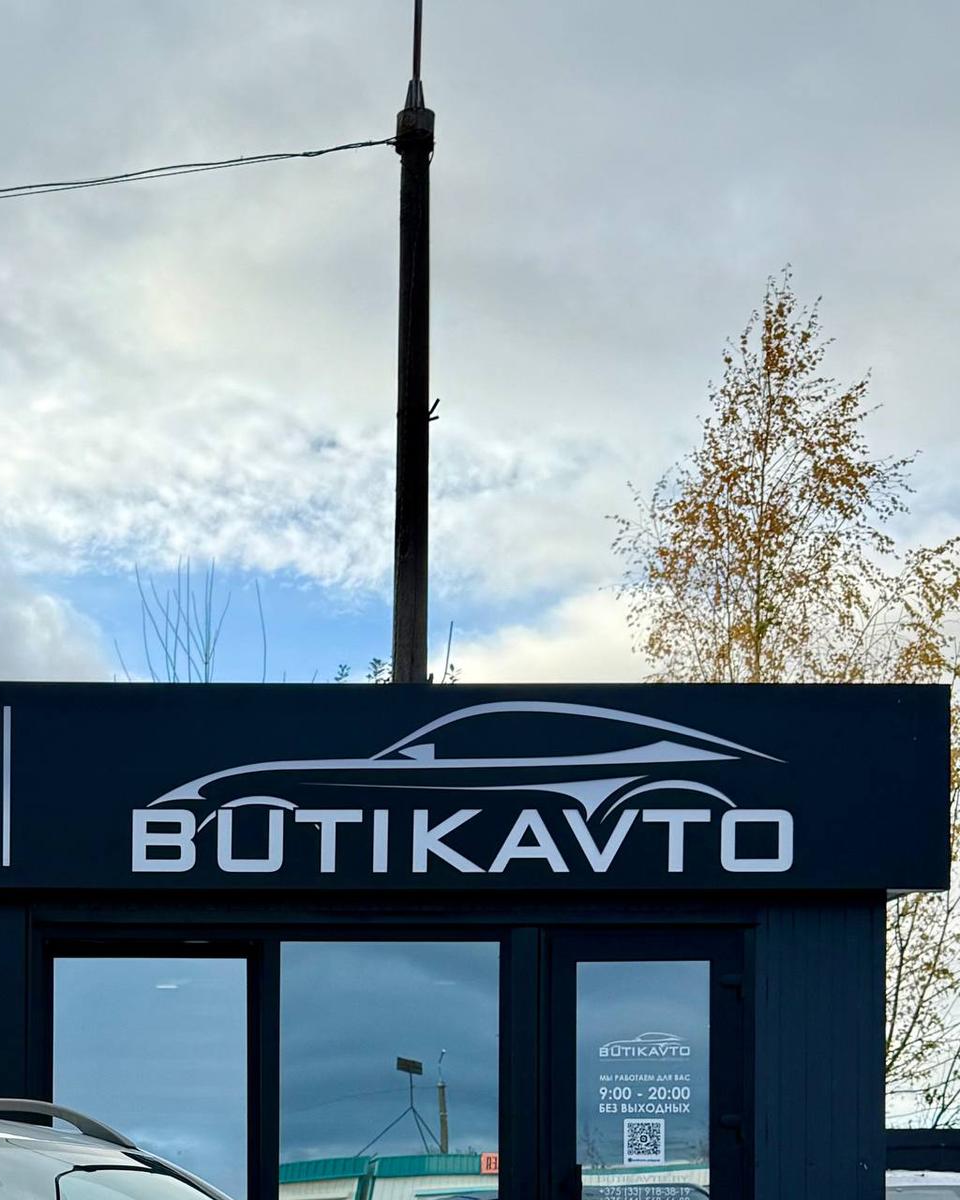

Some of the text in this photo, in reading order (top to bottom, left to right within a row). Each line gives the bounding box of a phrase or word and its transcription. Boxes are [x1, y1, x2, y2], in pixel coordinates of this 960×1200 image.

[131, 808, 794, 873] BUTIKAVTO
[599, 1046, 691, 1057] BUTIKAVTO
[656, 1074, 673, 1082] ДЛЯ
[599, 1086, 632, 1100] 9:00
[647, 1086, 691, 1100] 20:00
[599, 1103, 691, 1114] БЕЗ ВЫХОДНЫХ
